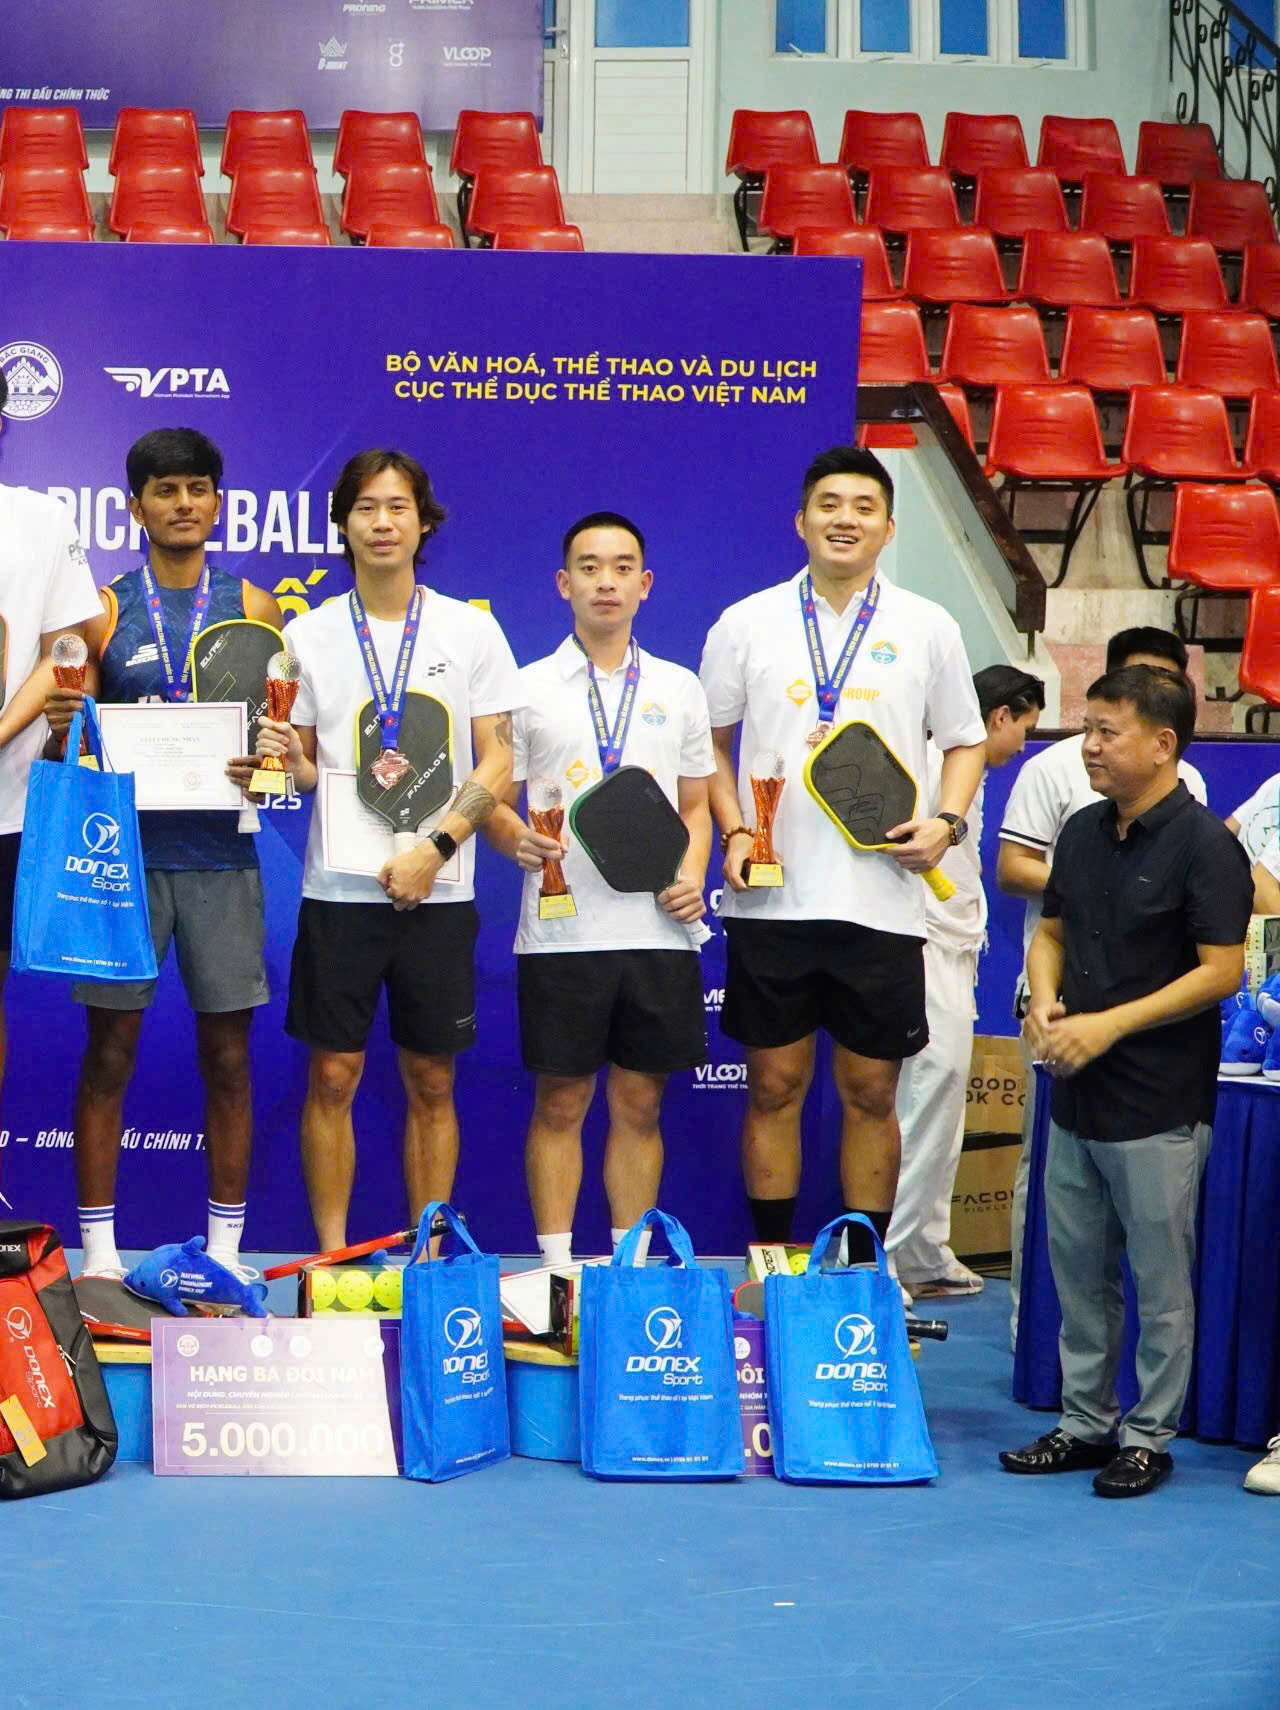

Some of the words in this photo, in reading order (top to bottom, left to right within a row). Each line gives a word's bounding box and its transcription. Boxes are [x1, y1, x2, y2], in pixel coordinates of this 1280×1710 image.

[443, 47, 491, 61] VLOOP
[15, 89, 30, 99] THI
[53, 86, 82, 100] CHÍNH
[19, 347, 50, 364] GIANG
[386, 351, 420, 376] BỘ
[428, 353, 478, 373] VĂN
[486, 351, 546, 377] HOÁ,
[553, 351, 599, 374] THỂ
[607, 358, 673, 376] THAO
[680, 353, 713, 377] VÀ
[720, 360, 755, 377] DU
[763, 359, 817, 381] LỊCH
[394, 381, 444, 402] CỤC
[451, 377, 498, 399] THỂ
[506, 383, 557, 404] DỤC
[563, 378, 610, 400] THỂ
[618, 383, 685, 402] THAO
[691, 382, 745, 407] VIỆT
[751, 387, 806, 404] NAM
[407, 752, 447, 799] FACOLOS
[65, 856, 129, 880] DONEX
[91, 877, 131, 892] Sport
[971, 1077, 1016, 1091] OOD
[35, 1128, 75, 1149] BÓNG
[121, 1128, 139, 1150] ẤU
[143, 1129, 190, 1151] CHÍNH
[625, 1356, 702, 1373] DONEX
[815, 1363, 888, 1380] DONEX
[24, 1346, 57, 1408] DONEX
[190, 1366, 247, 1386] HẠNG
[254, 1366, 279, 1382] BA
[663, 1373, 703, 1387] Sport
[851, 1378, 889, 1393] Sport
[181, 1422, 385, 1457] 5.000.000
